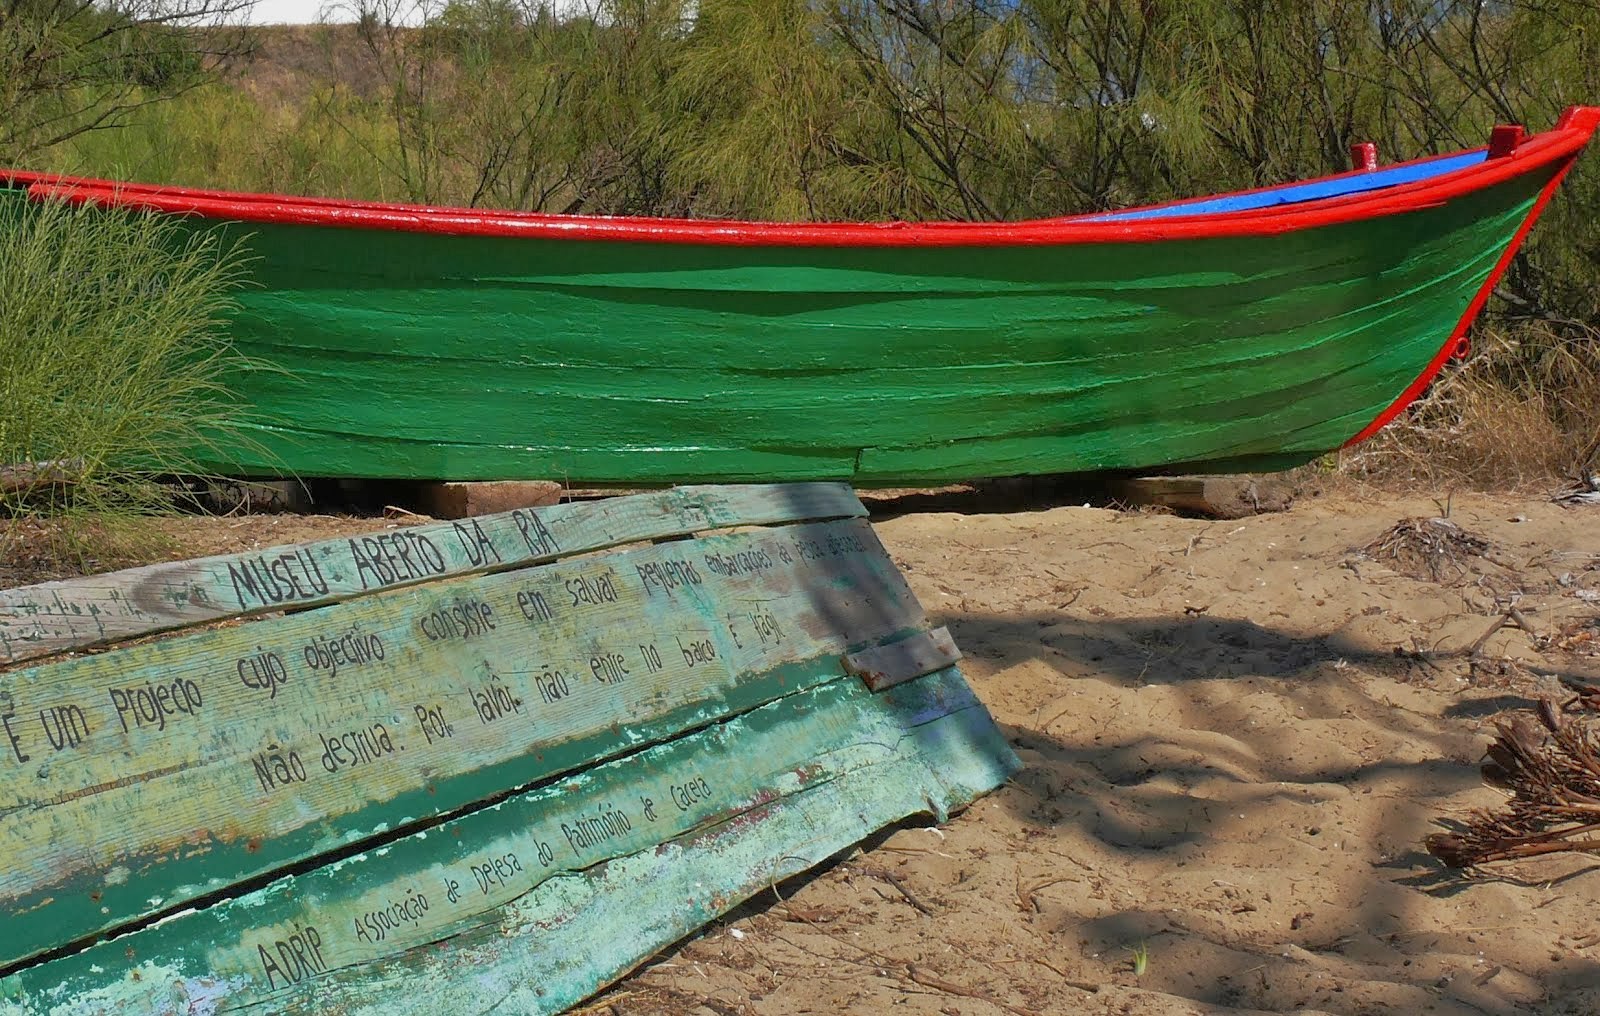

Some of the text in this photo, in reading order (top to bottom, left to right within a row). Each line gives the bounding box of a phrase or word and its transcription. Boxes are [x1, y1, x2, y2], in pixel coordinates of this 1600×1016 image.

[227, 509, 561, 611] MUSEU ABERTO DA RIA
[237, 646, 287, 699] cujo
[304, 633, 385, 678] objectivo
[420, 598, 496, 641] consiste
[516, 590, 552, 622] em
[635, 559, 702, 597] pequenas
[252, 745, 308, 793] Não
[535, 664, 569, 704] não
[590, 652, 630, 686] entre
[638, 643, 662, 674] no
[257, 776, 712, 990] ADRIP Associação de Defesa do Património de Cacela
